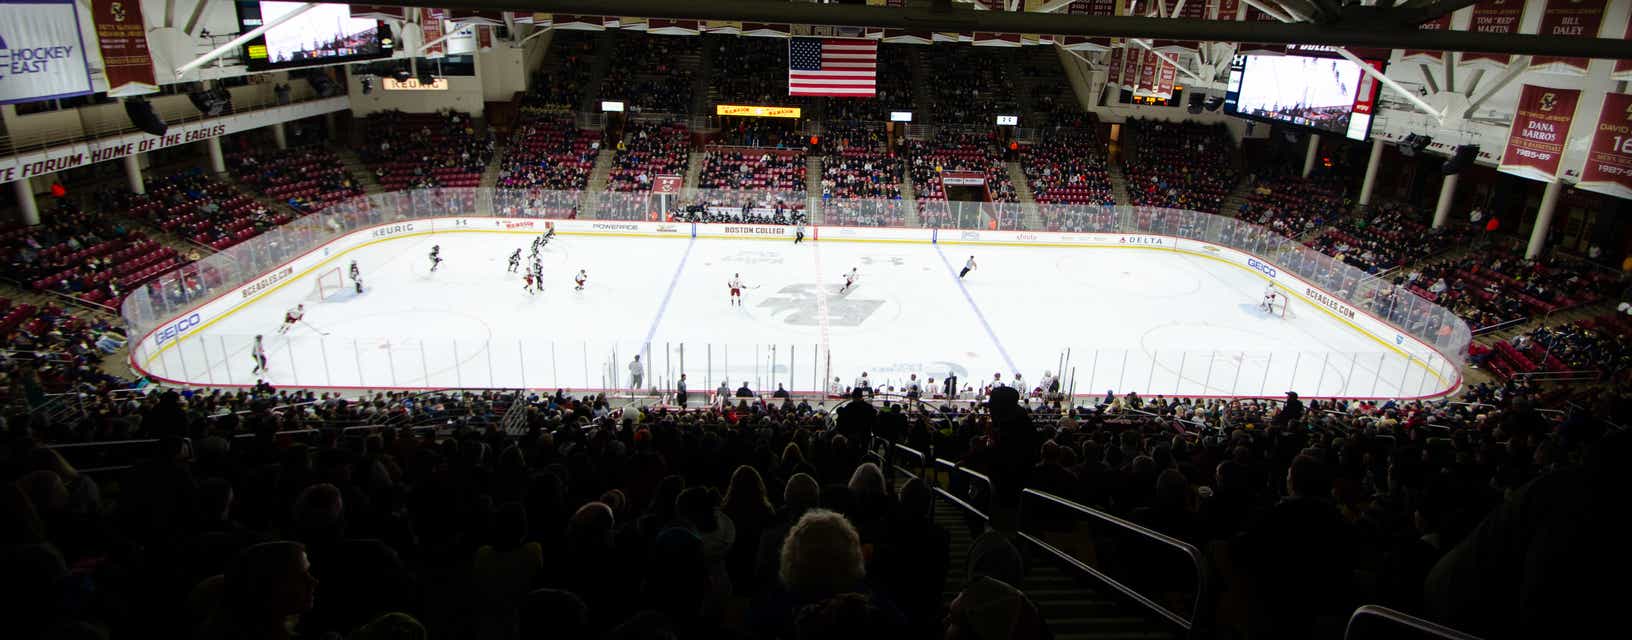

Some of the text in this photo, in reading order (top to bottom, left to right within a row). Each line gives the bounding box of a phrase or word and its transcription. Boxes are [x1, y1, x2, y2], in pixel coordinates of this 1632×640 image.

[1552, 26, 1583, 36] DALEY
[11, 46, 72, 61] HOCKEY
[11, 60, 48, 74] EAST
[1528, 121, 1554, 132] DANA
[1600, 122, 1629, 134] DAVID
[1522, 128, 1556, 142] BARROS
[22, 154, 82, 178] FORUM
[90, 143, 134, 164] HOME
[138, 139, 155, 152] OF
[160, 132, 182, 148] THE
[185, 125, 225, 142] EAGLES
[373, 223, 414, 238] KEURIG
[724, 226, 785, 235] BOSTON COLLEGE
[1129, 236, 1163, 245] DELTA
[1247, 258, 1277, 278] GEICO
[1305, 287, 1356, 320] BCEAGLES.COM
[155, 313, 201, 346] GEICO
